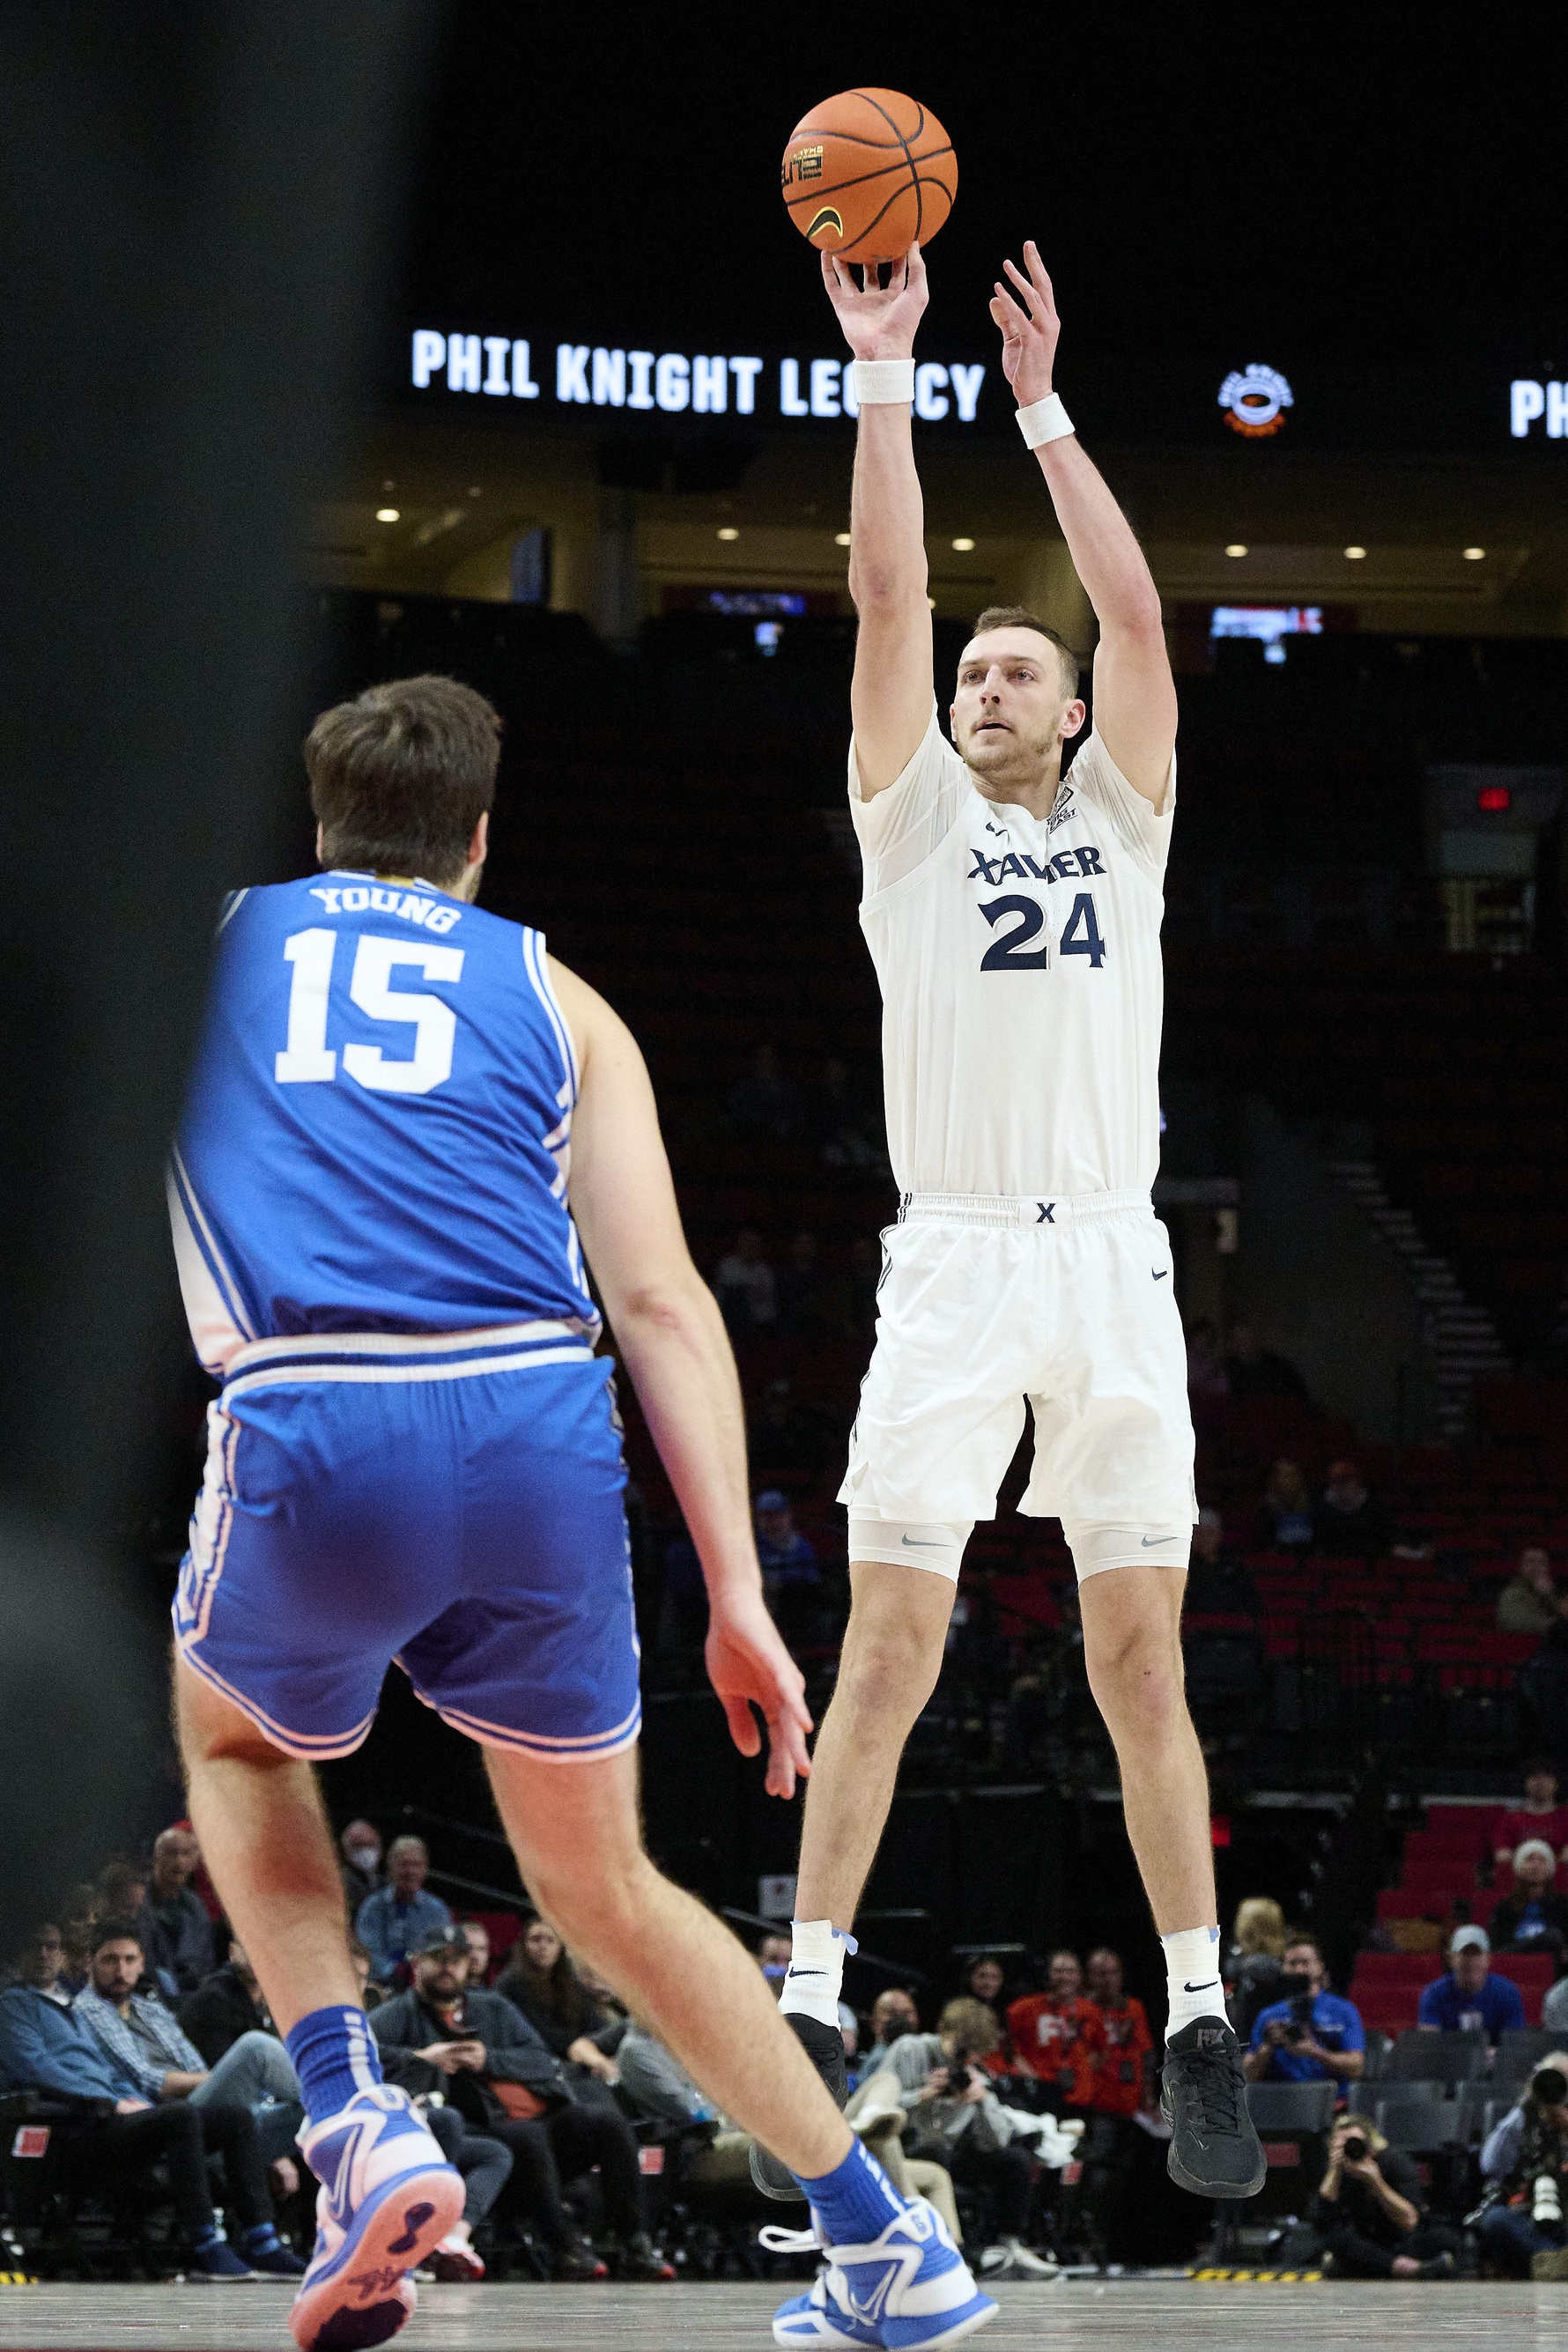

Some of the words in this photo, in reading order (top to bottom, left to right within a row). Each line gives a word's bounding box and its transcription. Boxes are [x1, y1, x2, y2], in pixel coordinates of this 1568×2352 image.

[411, 329, 540, 399] PHIL
[556, 344, 764, 416] KNIGHT
[780, 358, 986, 422] LECY
[309, 887, 462, 935] YOUNG
[977, 892, 1107, 973] 24
[275, 928, 466, 1095] 15
[1035, 1202, 1056, 1224] X
